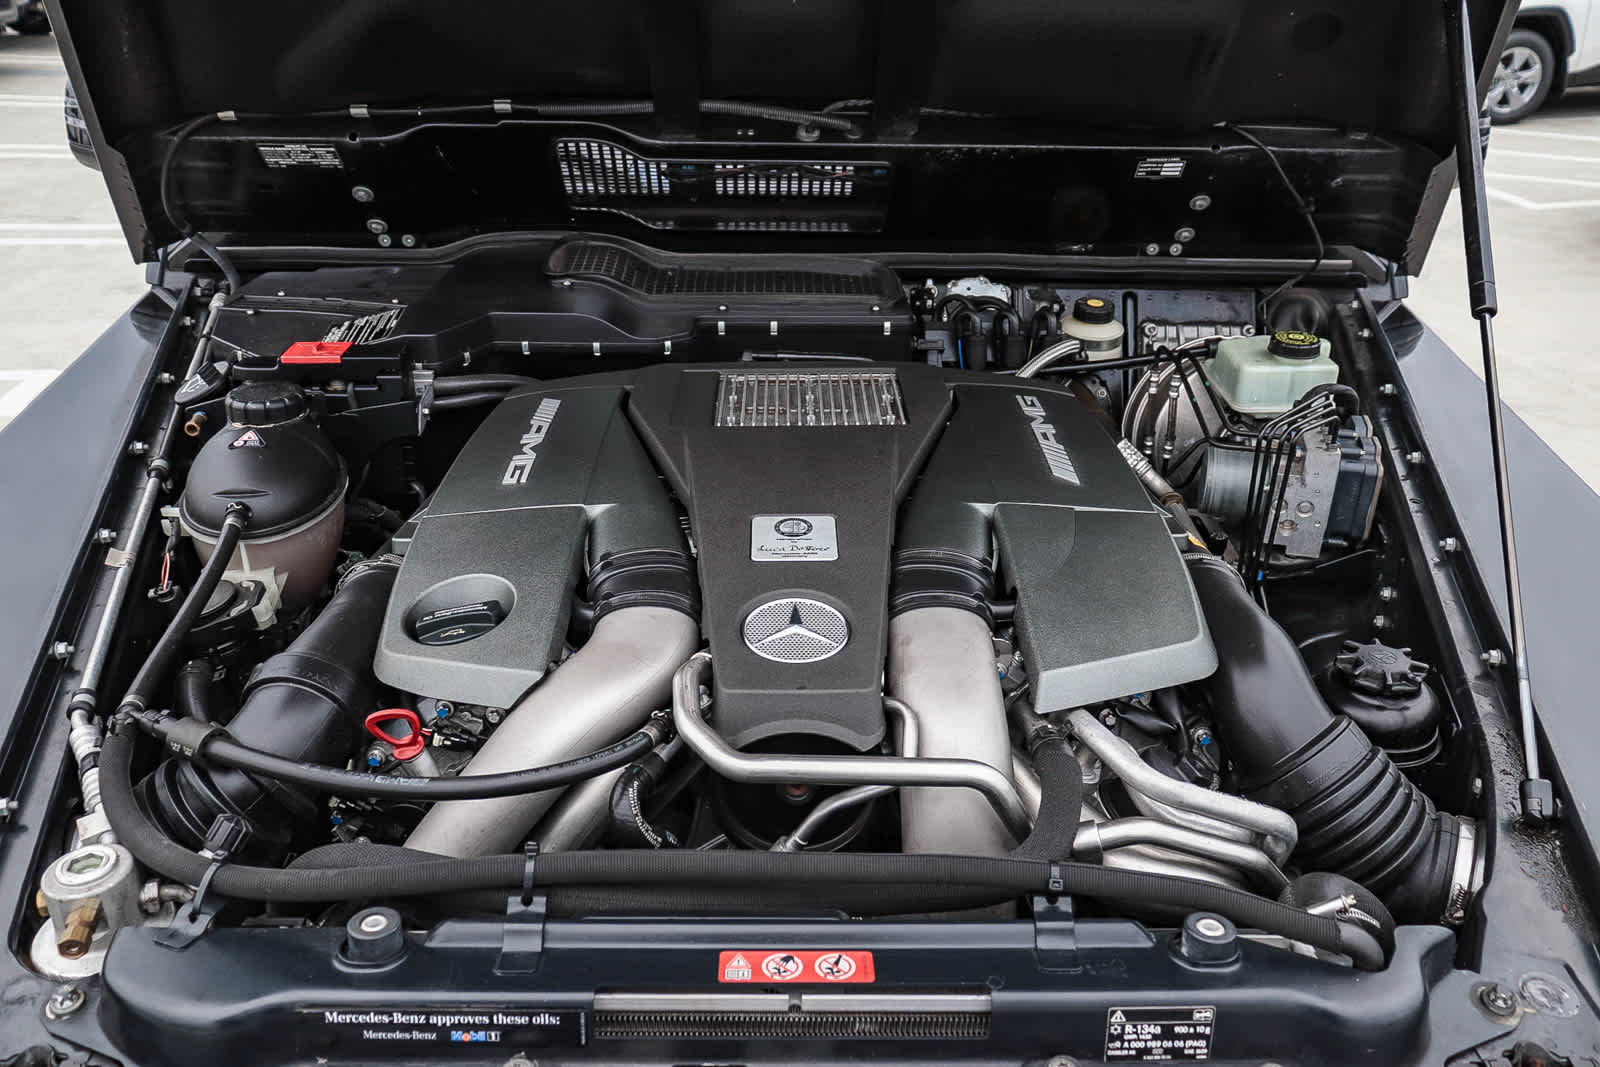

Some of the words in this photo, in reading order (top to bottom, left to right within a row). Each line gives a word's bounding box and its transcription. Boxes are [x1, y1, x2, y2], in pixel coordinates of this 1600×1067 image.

[502, 418, 551, 485] AMG
[324, 1011, 427, 1025] Mercedes-Benz
[429, 1014, 490, 1027] approves
[492, 1012, 529, 1025] these
[532, 1012, 561, 1025] oils:
[362, 1030, 437, 1041] Mercedes-Benz
[450, 1031, 486, 1042] Mobil
[1124, 1024, 1161, 1034] R-134a
[1196, 1025, 1205, 1034] 10
